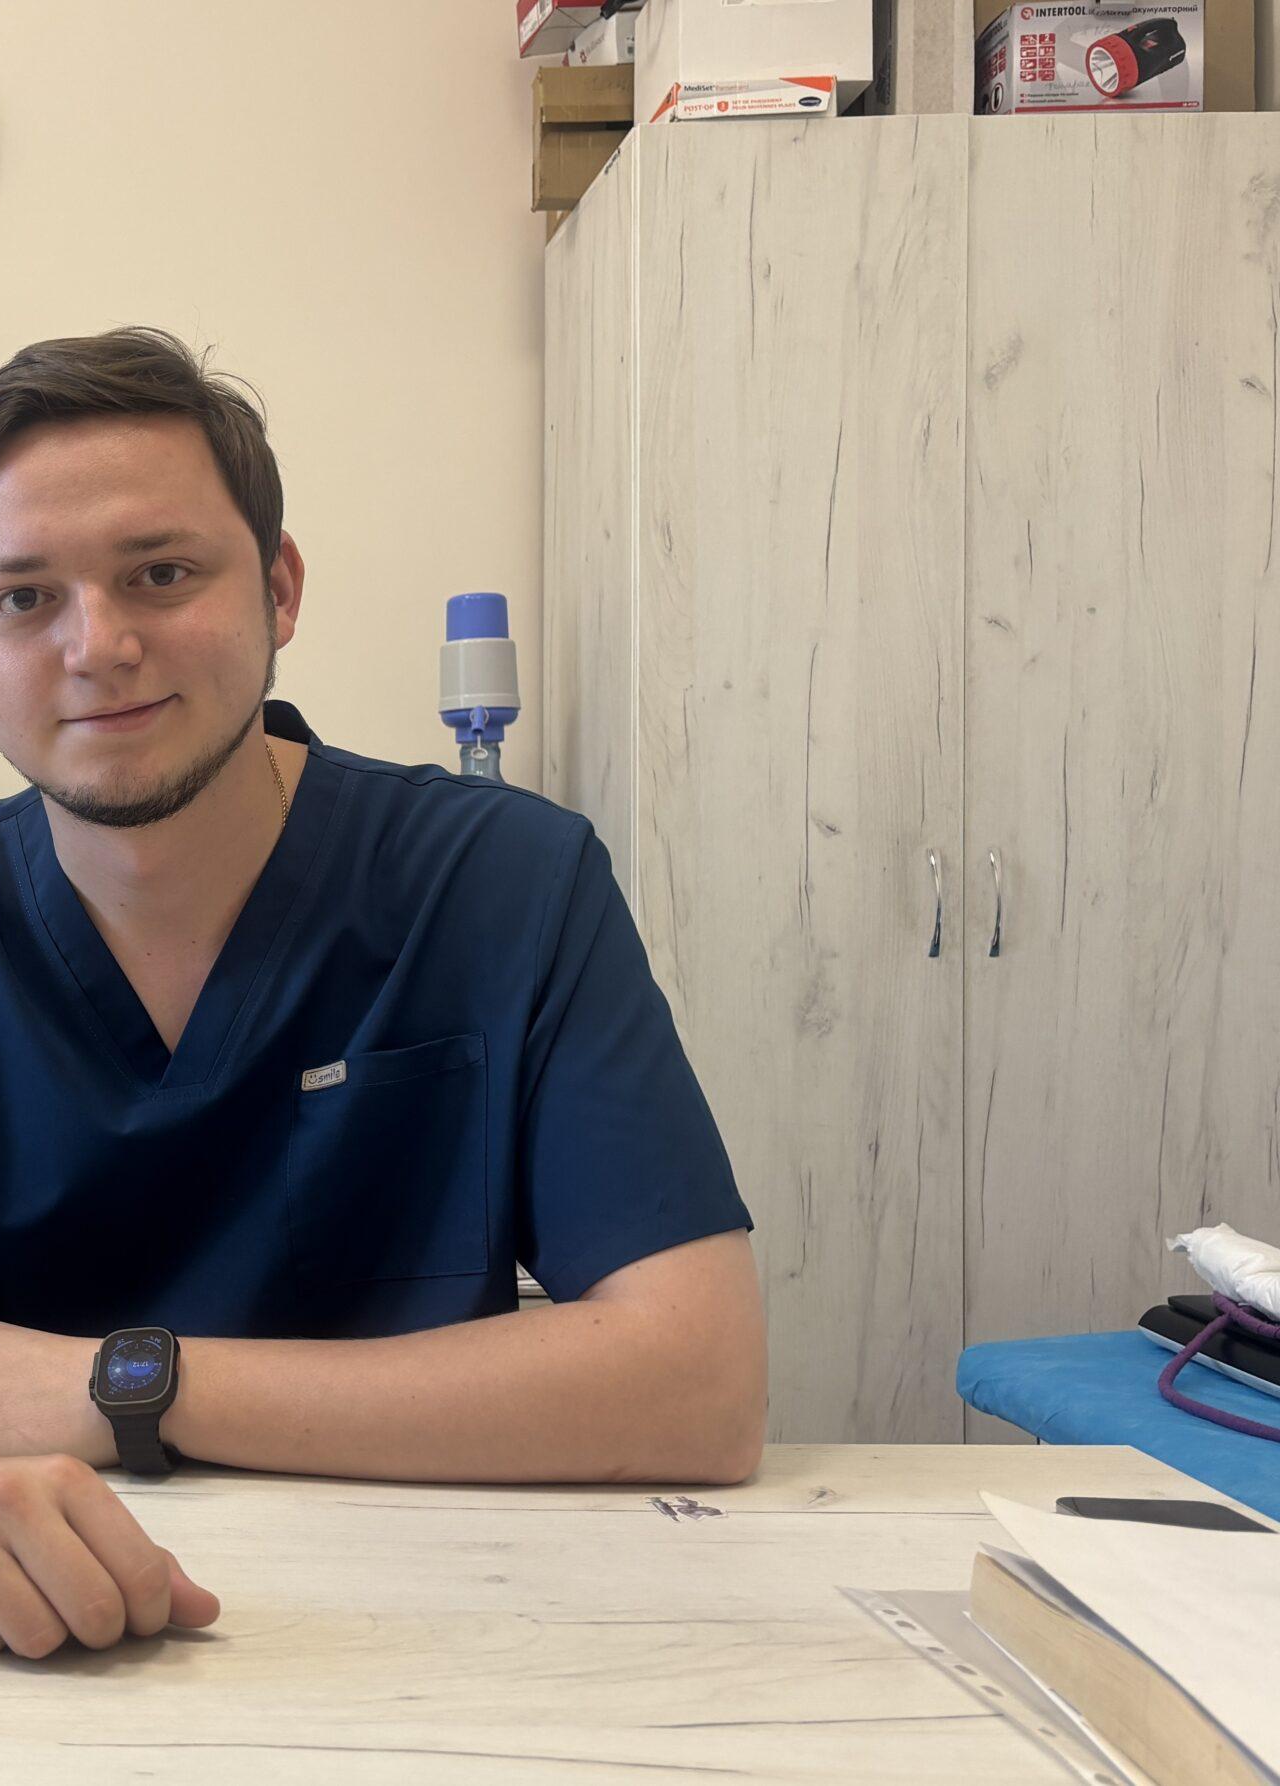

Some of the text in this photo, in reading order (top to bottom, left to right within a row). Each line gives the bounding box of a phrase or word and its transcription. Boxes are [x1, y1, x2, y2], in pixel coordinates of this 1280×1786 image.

[1035, 6, 1086, 17] INTERTOOL
[1132, 5, 1198, 14] акумуляторний
[684, 103, 714, 112] POST-OP
[318, 1066, 341, 1084] smile
